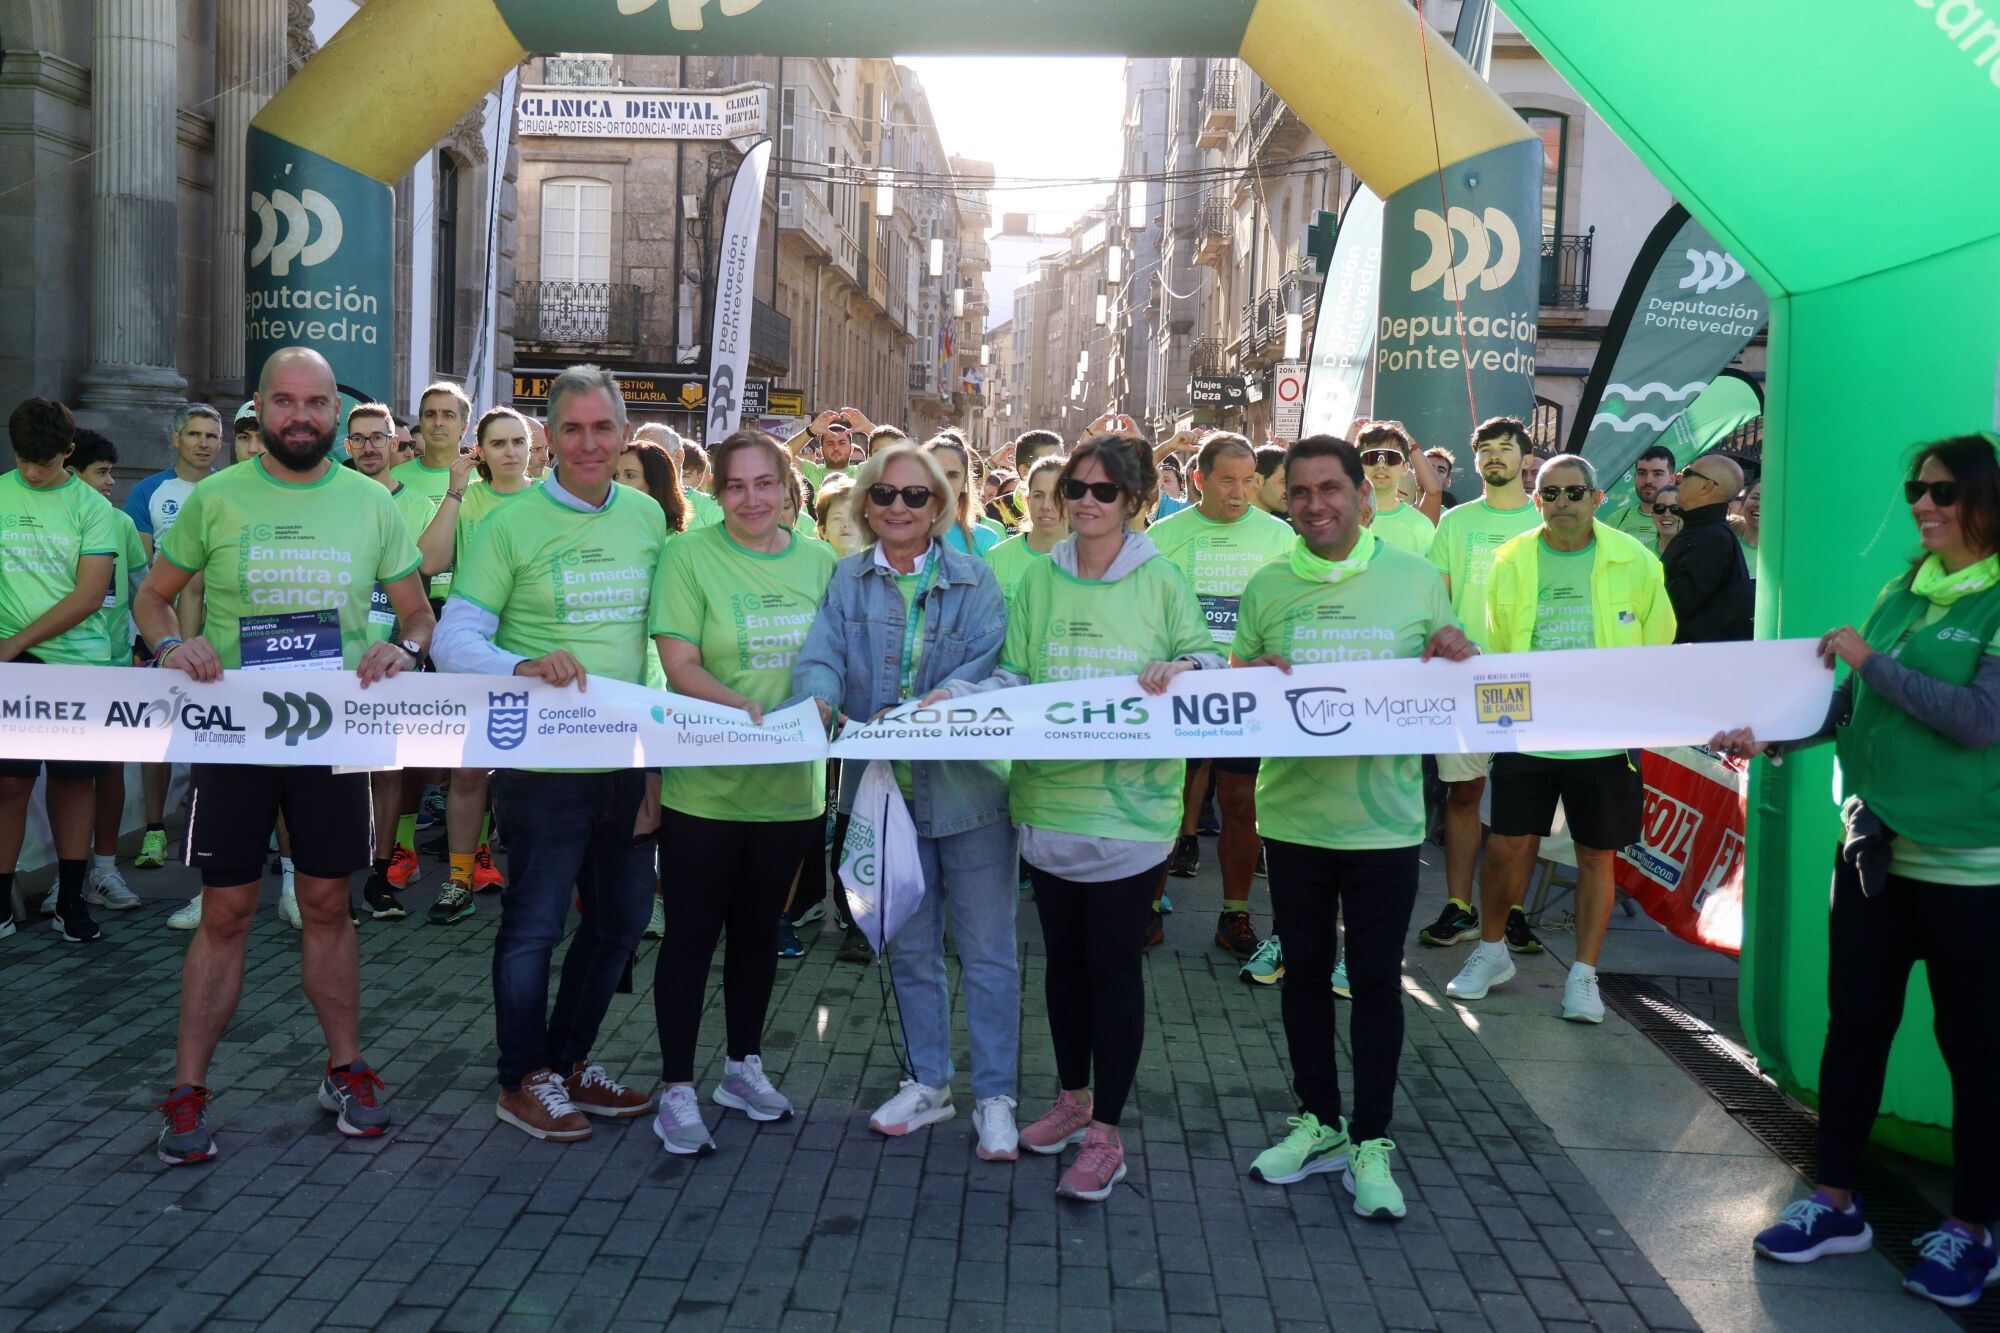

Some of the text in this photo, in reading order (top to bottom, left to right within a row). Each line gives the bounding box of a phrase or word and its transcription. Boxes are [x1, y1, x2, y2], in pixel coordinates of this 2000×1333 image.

[522, 98, 719, 120] CLINICA DENTAL
[726, 94, 760, 110] CLINICA
[725, 109, 760, 125] DENTAL
[718, 233, 739, 353] Deputación
[729, 235, 748, 354] Pontevedra
[1323, 244, 1361, 368] Deputación
[1340, 247, 1380, 369] Pontevedra
[1648, 297, 1759, 321] Deputación
[1380, 312, 1537, 345] Deputación
[1644, 312, 1755, 337] Pontevedra
[1378, 344, 1535, 376] Pontevedra
[512, 378, 550, 397] LE
[616, 380, 655, 390] ESTION
[1194, 380, 1222, 390] Viajes
[619, 391, 668, 401] OBILIARIA
[1193, 390, 1221, 400] Deza
[250, 545, 352, 563] En marcha
[1195, 550, 1263, 562] En marcha
[247, 565, 352, 585] contra o
[563, 566, 647, 585] En marcha
[1194, 564, 1249, 577] contra
[251, 586, 349, 607] cancro
[371, 592, 388, 604] 88
[566, 586, 634, 606] contra
[1205, 611, 1238, 623] 0971
[1537, 604, 1554, 616] En
[746, 614, 770, 629] En
[731, 593, 750, 671] PONTEVEDRA
[1294, 624, 1395, 641] En marcha
[266, 633, 317, 652] 2017
[1049, 641, 1138, 661] En marcha
[1290, 644, 1371, 663] contra
[1482, 688, 1524, 704] SOLAN
[0, 695, 87, 721] MÍREZ
[344, 698, 467, 720] Deputación
[538, 706, 596, 720] Concello
[872, 706, 1014, 726] KODA
[1044, 696, 1149, 725] CHS
[1172, 691, 1257, 726] NGP
[1302, 696, 1456, 725] Mira Maruxa
[344, 719, 466, 735] Pontevedra
[538, 720, 638, 735] de Pontevedra
[1396, 715, 1452, 727] OPTICA
[677, 731, 724, 746] Miguel
[950, 725, 1015, 737] Motor
[1044, 731, 1151, 740] CONSTRUCCIONES
[1174, 727, 1243, 739] Good pet food
[1643, 788, 1700, 865] ROIZ
